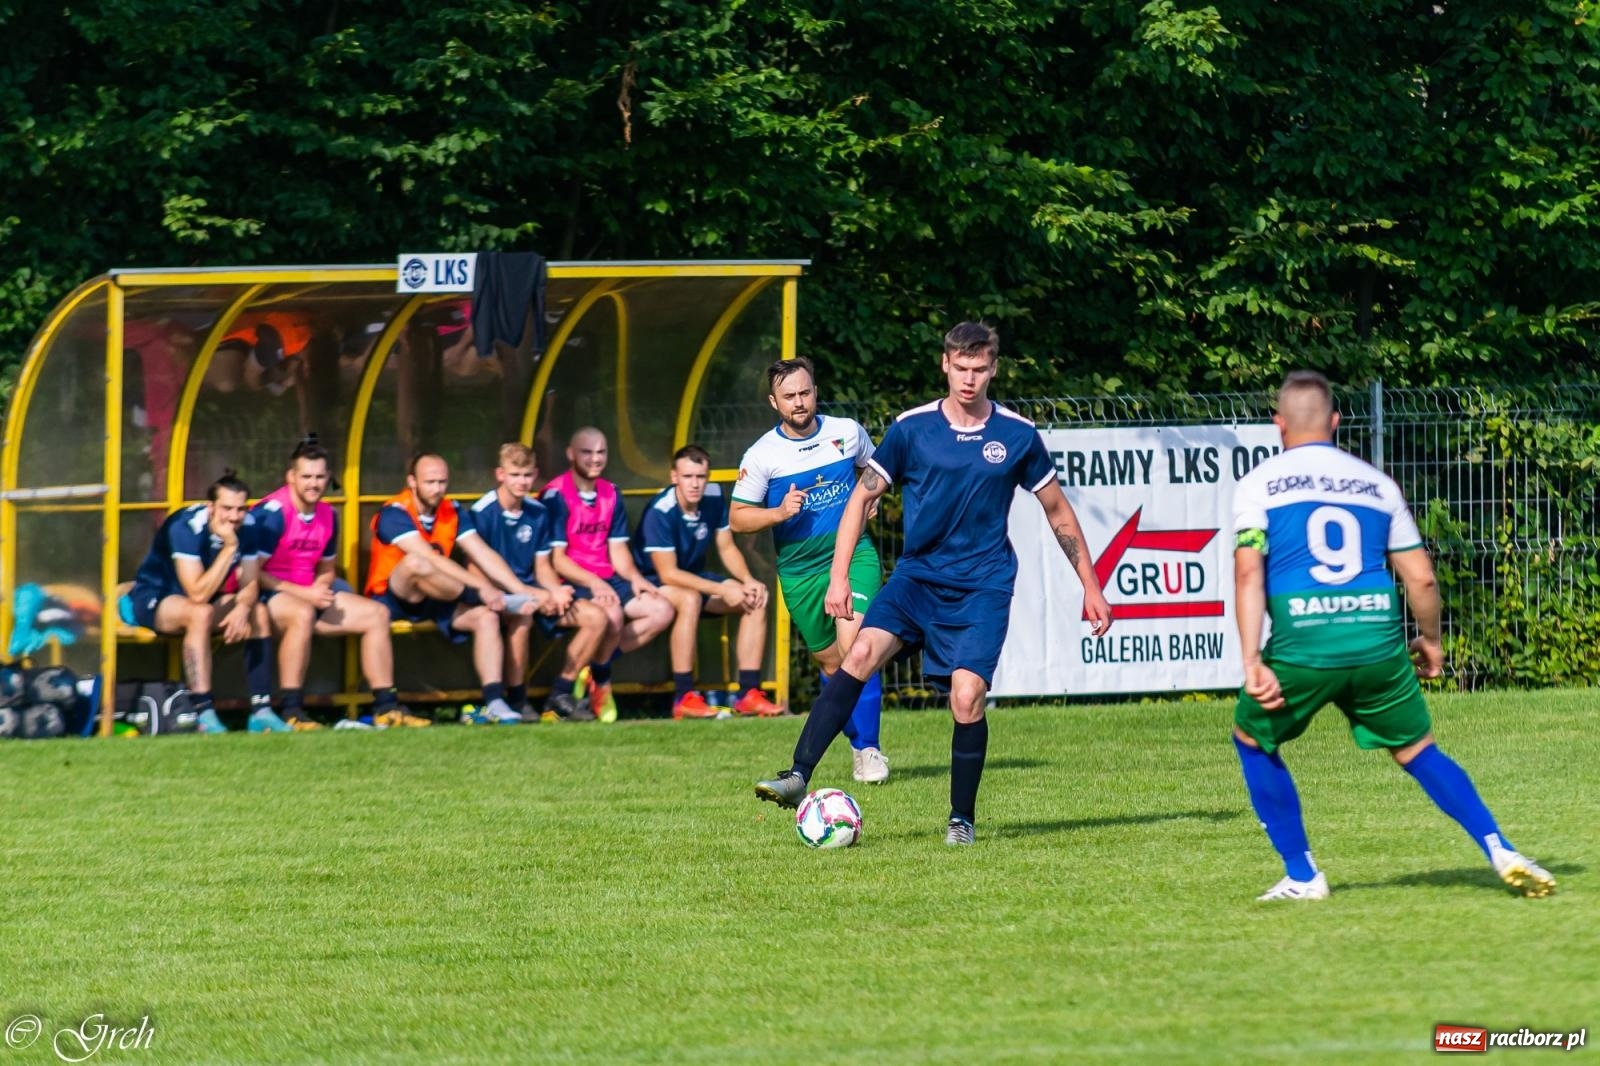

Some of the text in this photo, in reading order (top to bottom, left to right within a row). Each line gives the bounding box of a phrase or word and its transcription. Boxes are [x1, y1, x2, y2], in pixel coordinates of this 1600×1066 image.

[434, 259, 468, 285] LKS
[1167, 447, 1219, 485] LKS
[1306, 505, 1363, 585] 9
[1116, 561, 1206, 596] GRUD
[1287, 593, 1391, 616] RAUDEN
[1081, 632, 1224, 664] GALERIA BARW
